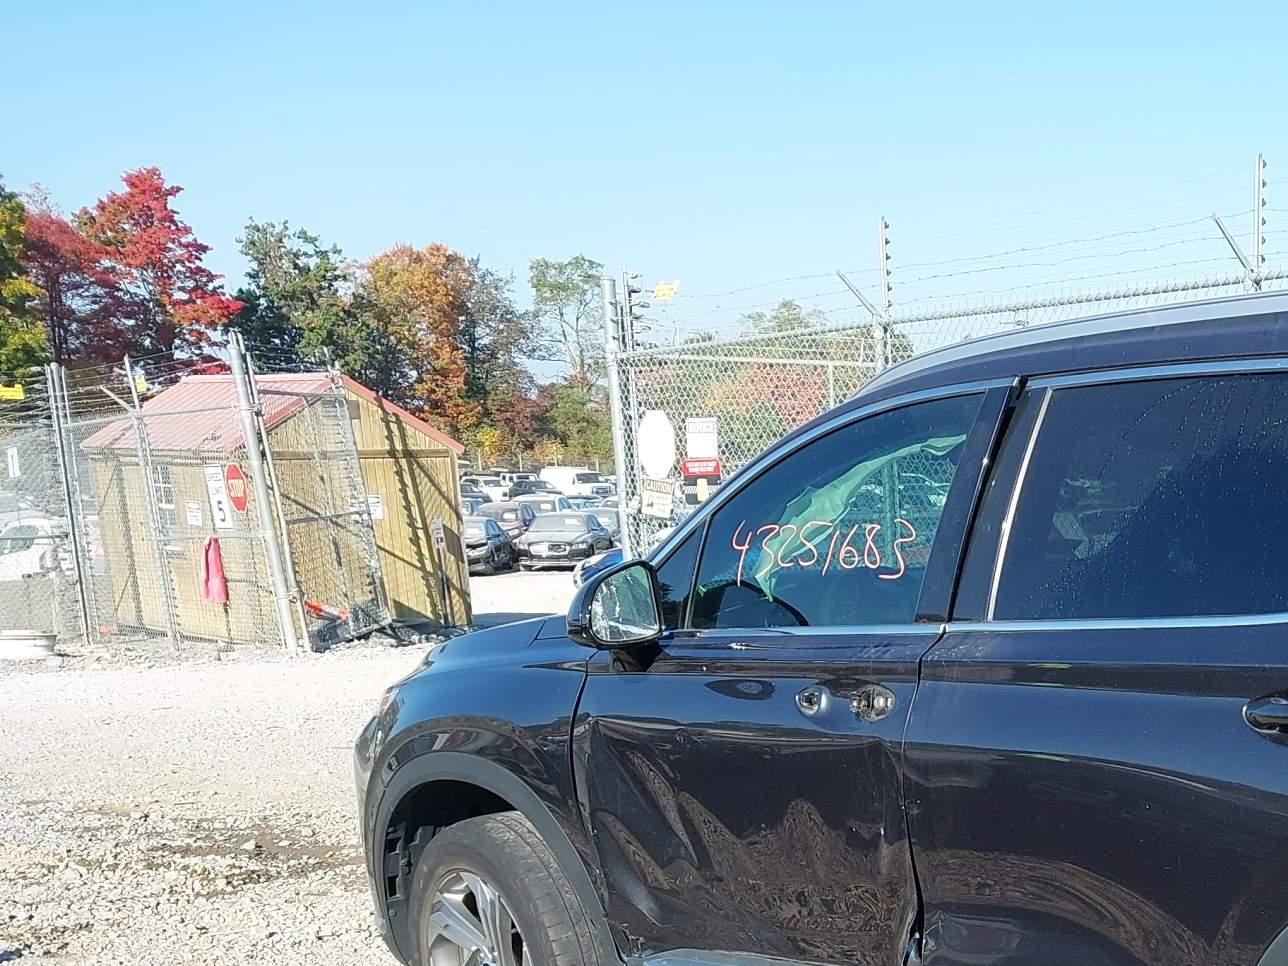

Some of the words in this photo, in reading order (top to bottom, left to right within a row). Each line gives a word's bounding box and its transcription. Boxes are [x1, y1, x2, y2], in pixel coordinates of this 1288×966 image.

[228, 479, 245, 498] STOP
[645, 480, 672, 494] CAUTION
[217, 500, 226, 522] 5
[732, 518, 917, 588] 43251683
